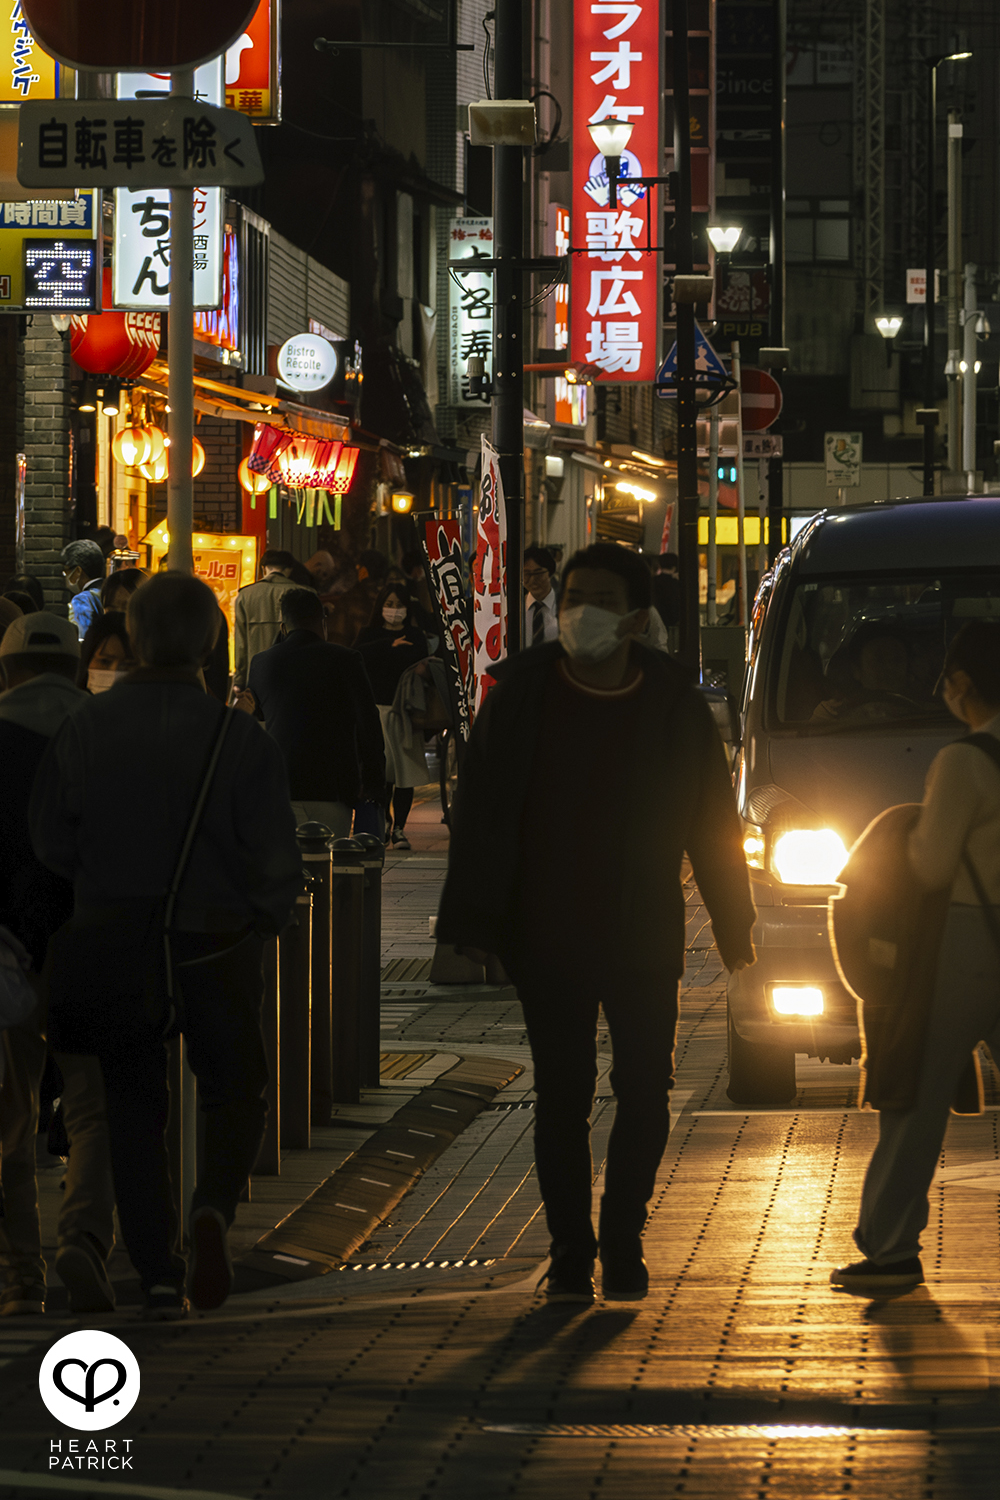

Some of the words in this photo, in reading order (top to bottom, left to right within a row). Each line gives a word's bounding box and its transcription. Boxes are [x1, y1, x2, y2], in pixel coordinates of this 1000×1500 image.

[39, 115, 245, 171] 自転車を除く
[26, 241, 92, 307] 空
[583, 211, 644, 378] 歌広場
[287, 345, 315, 358] Bistro
[723, 321, 763, 338] PUB
